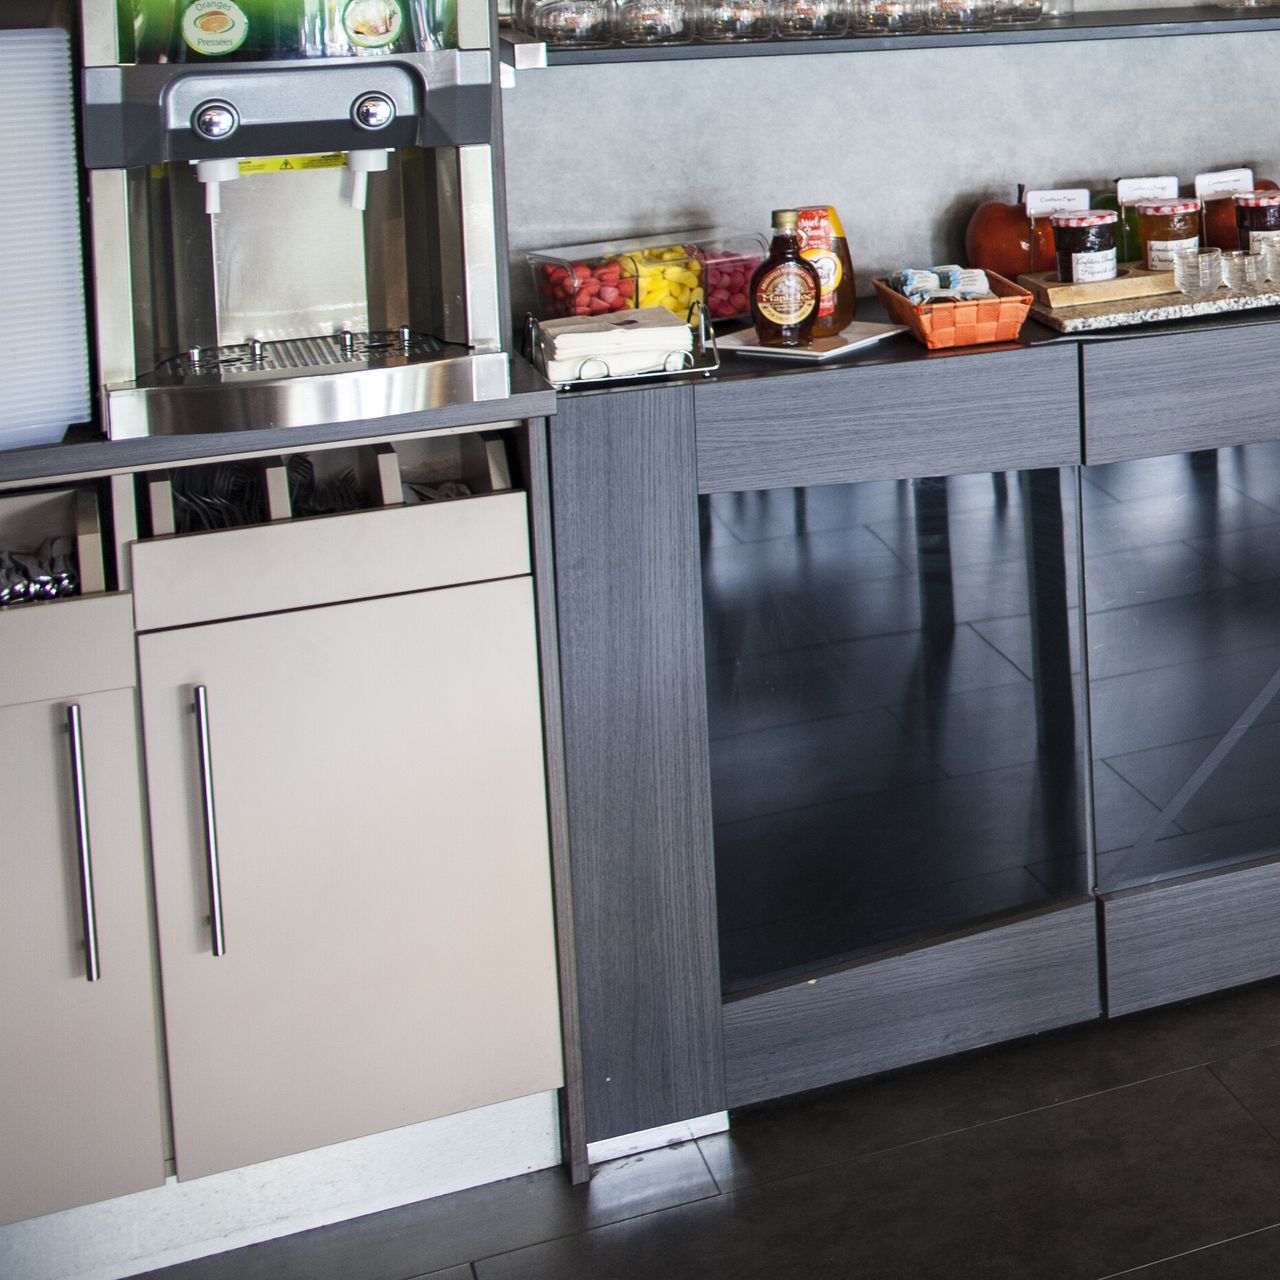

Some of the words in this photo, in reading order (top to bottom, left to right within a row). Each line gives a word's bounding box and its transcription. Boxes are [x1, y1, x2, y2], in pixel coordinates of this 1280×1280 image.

[195, 1, 232, 11] Oranges
[197, 38, 234, 46] Pressées
[761, 293, 794, 303] Maple
